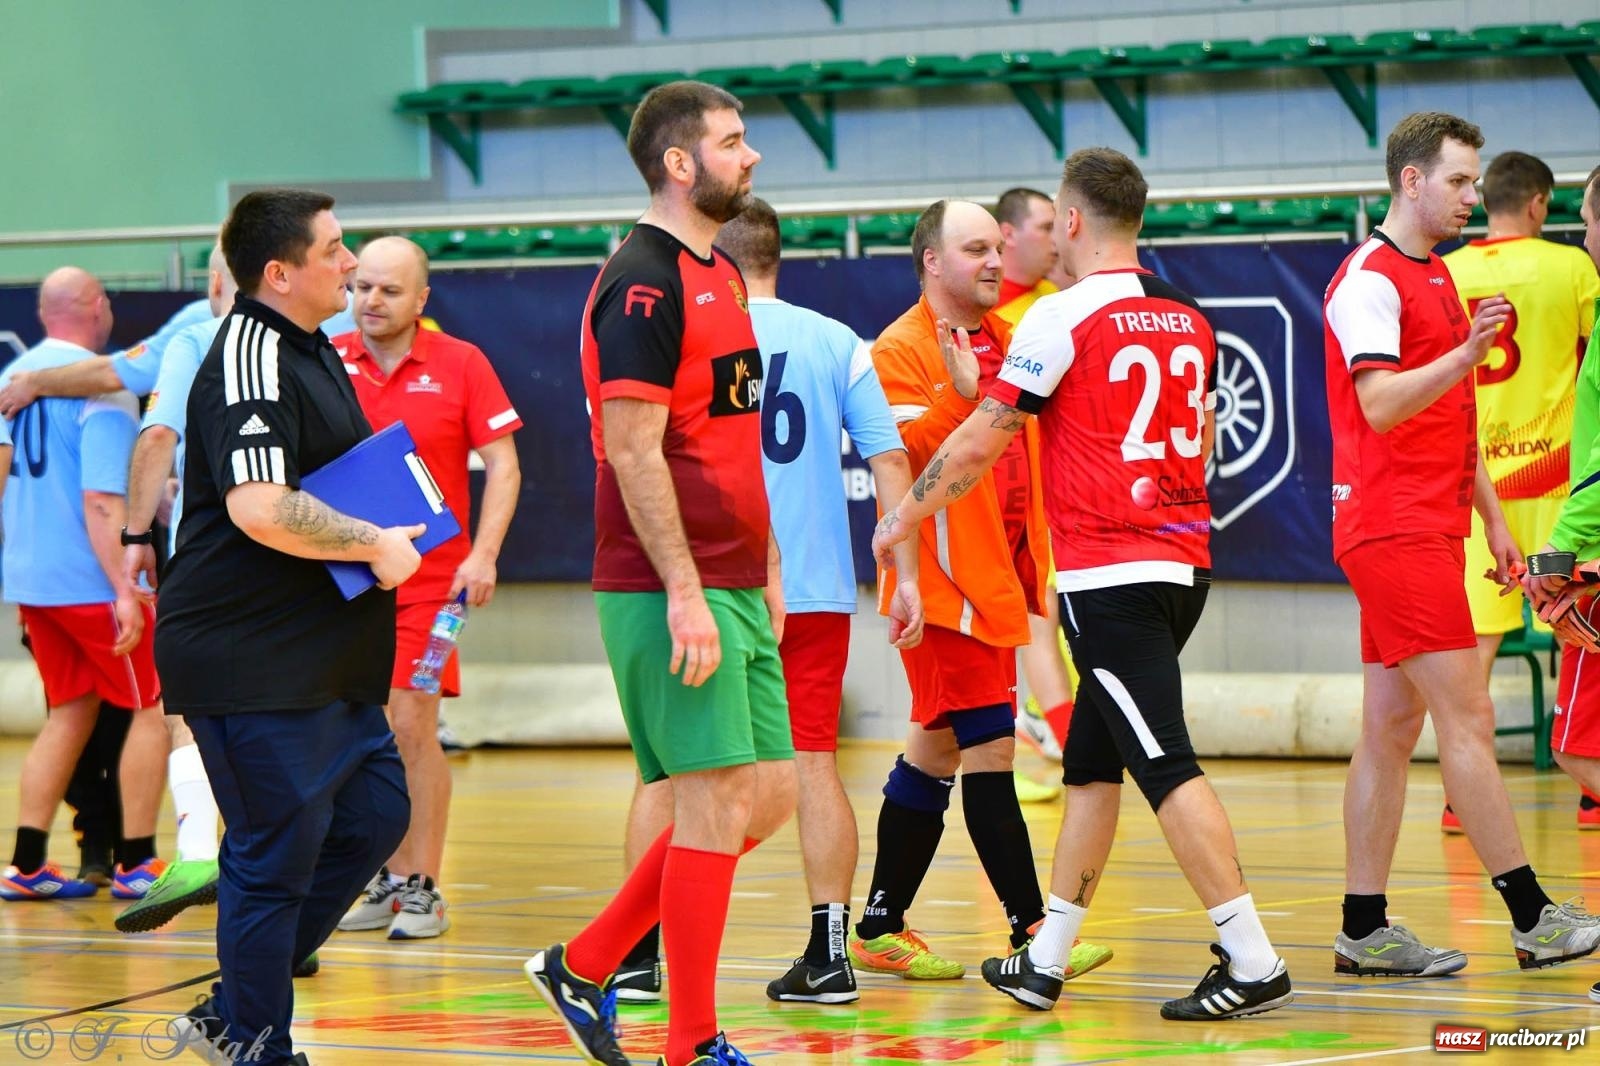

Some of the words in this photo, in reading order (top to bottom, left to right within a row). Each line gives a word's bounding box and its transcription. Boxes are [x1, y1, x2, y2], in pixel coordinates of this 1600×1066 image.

[1108, 311, 1196, 334] TRENER
[760, 350, 807, 465] 6
[1108, 344, 1206, 463] 23
[239, 425, 271, 436] adidas
[1485, 438, 1553, 461] HOLIDAY
[865, 905, 888, 916] ZEUS
